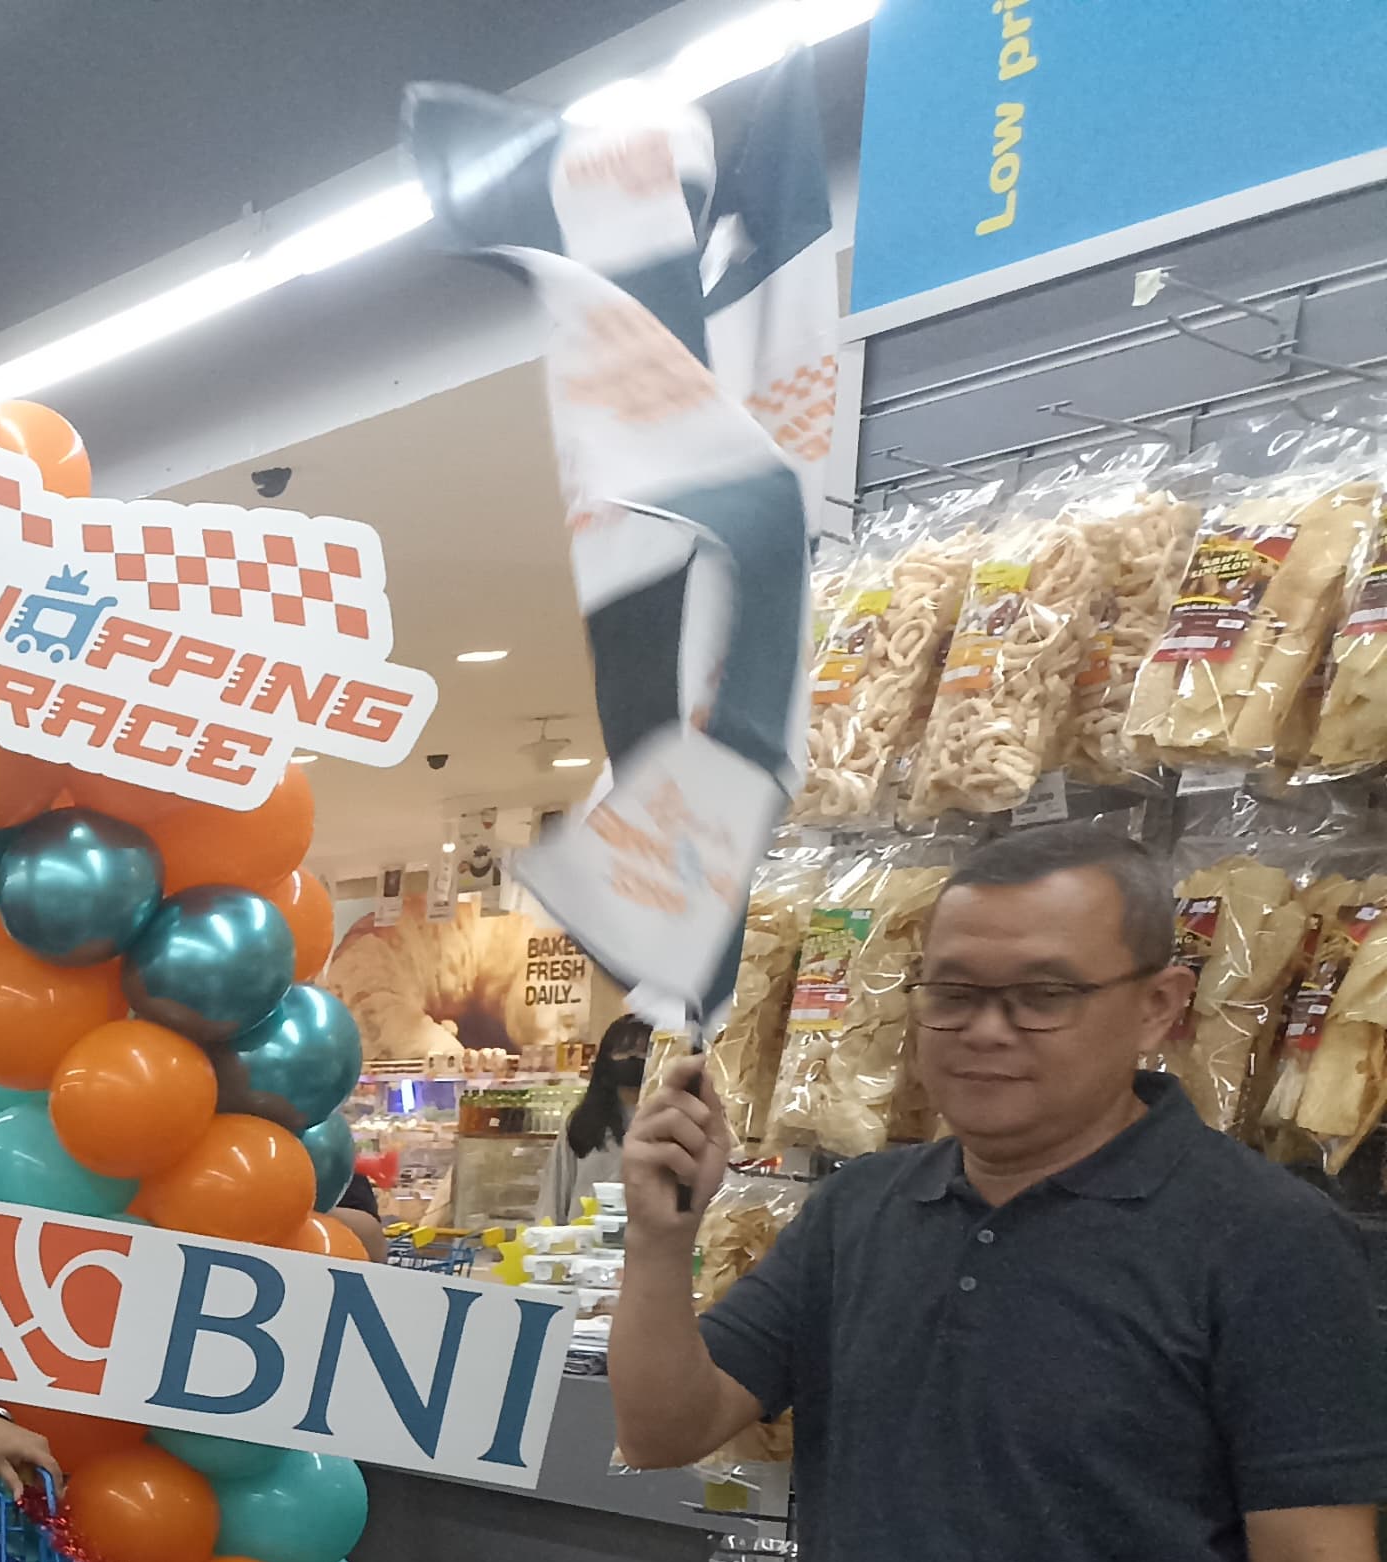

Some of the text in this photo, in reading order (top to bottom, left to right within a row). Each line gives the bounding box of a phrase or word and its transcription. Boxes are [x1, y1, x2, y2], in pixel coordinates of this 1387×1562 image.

[975, 102, 1025, 237] Low
[526, 959, 587, 982] FRESH
[527, 935, 580, 959] BAKE
[143, 1243, 562, 1468] BNI
